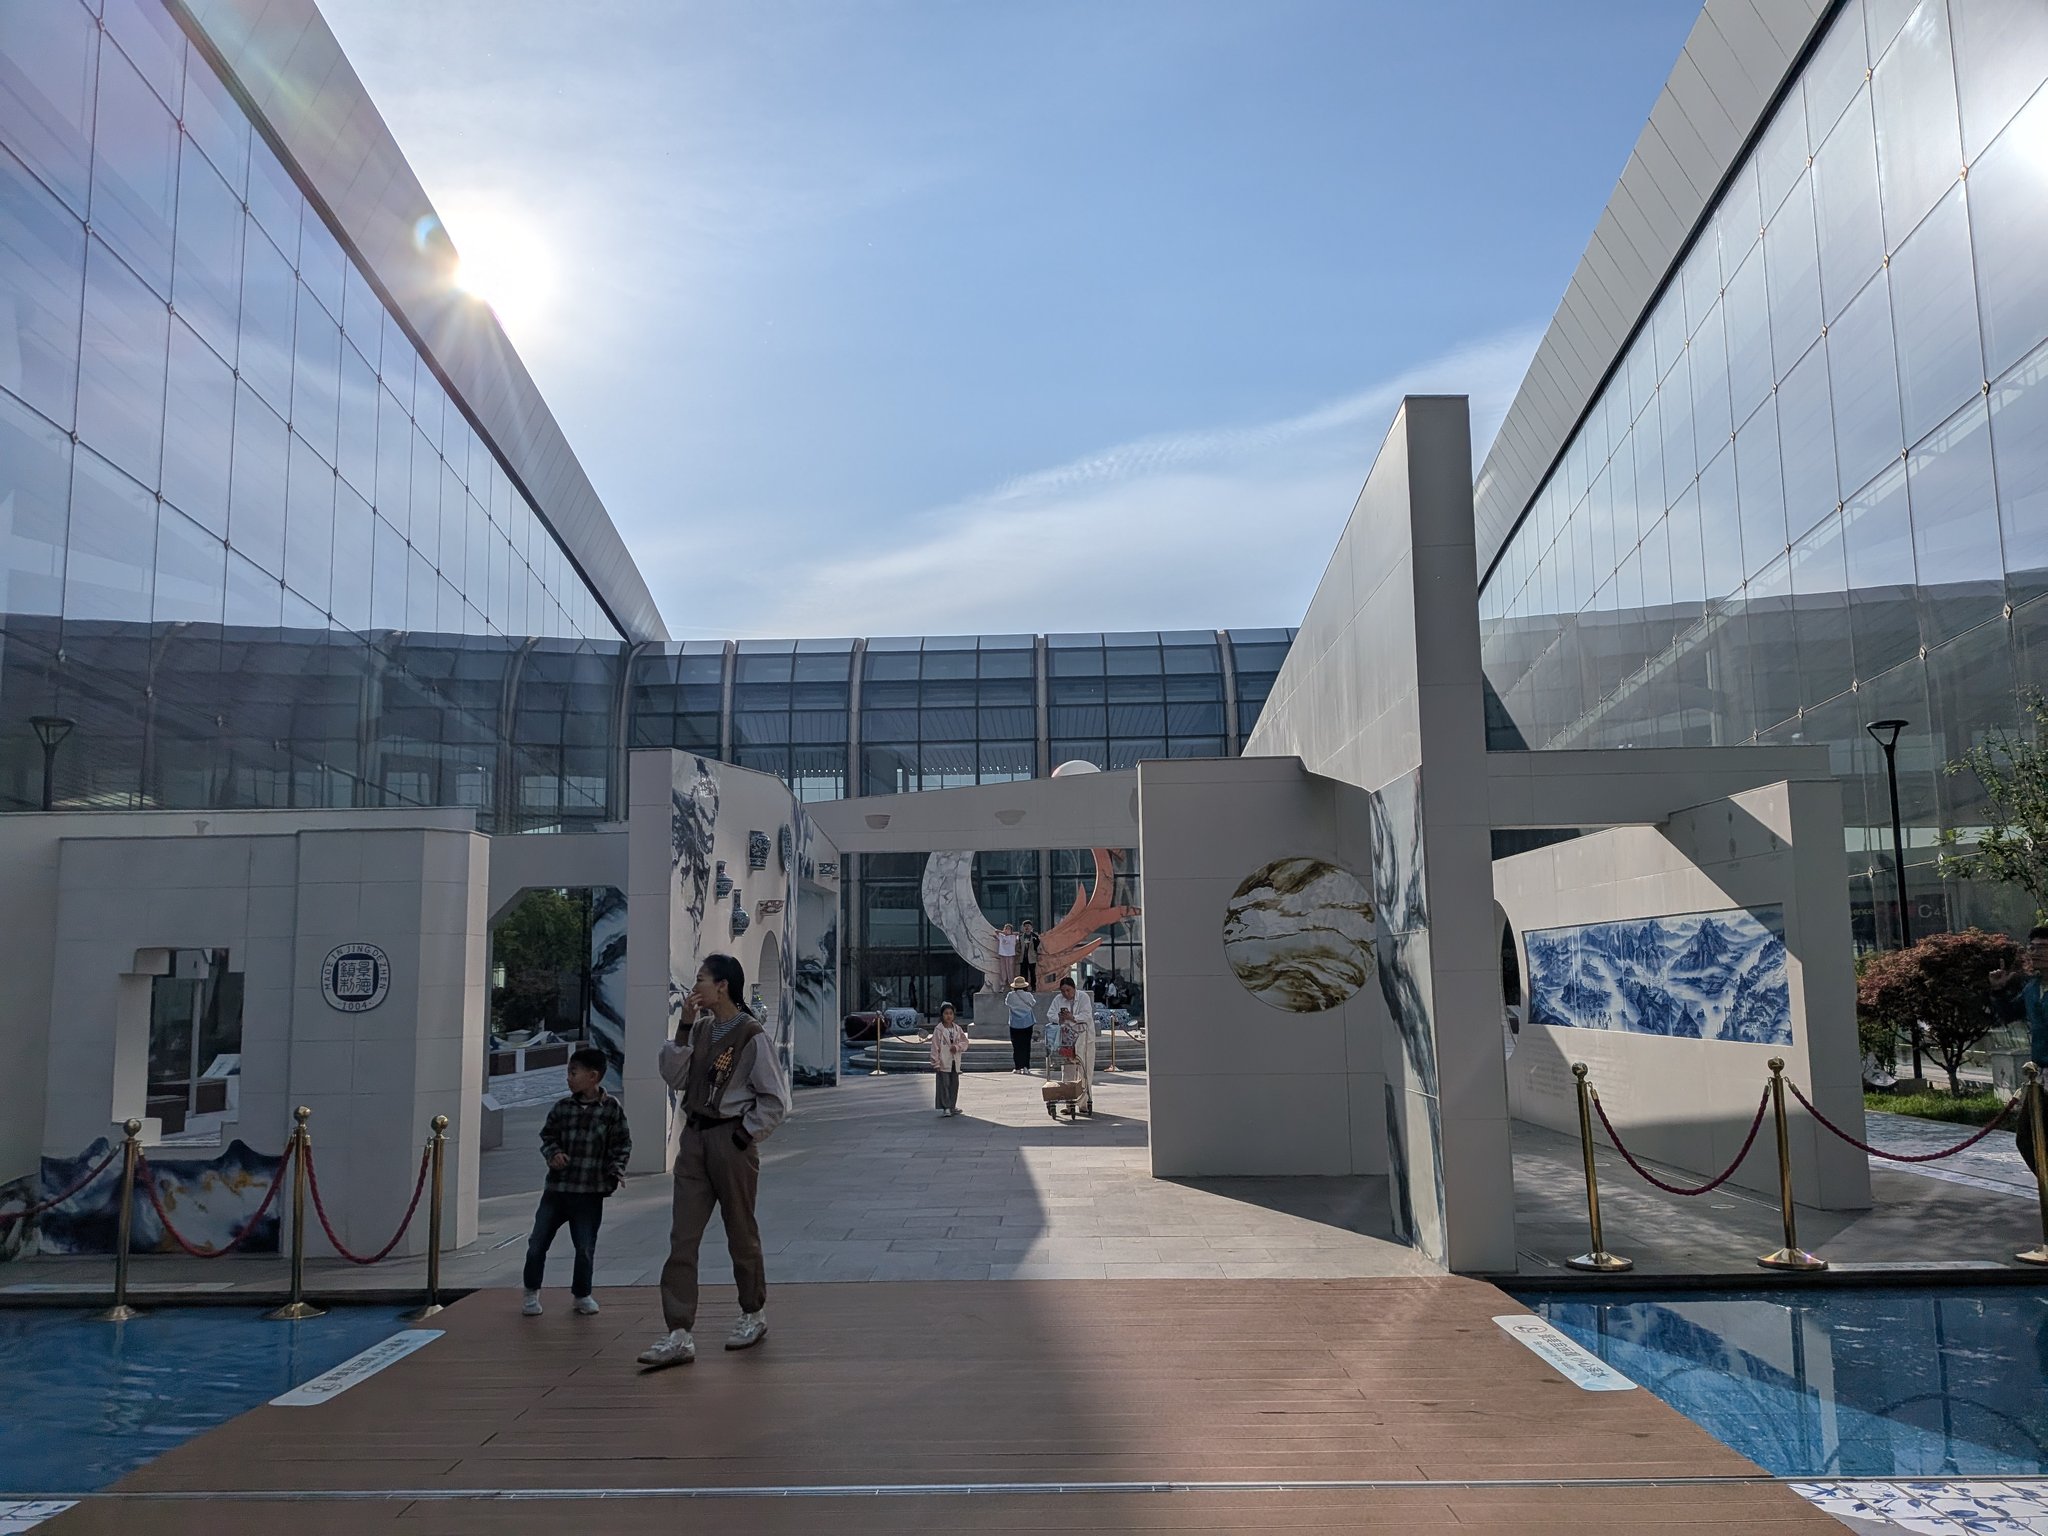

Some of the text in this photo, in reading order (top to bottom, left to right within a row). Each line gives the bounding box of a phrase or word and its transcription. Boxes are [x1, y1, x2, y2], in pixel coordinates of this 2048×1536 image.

[324, 946, 387, 990] MADE IN JINGDEZHEN
